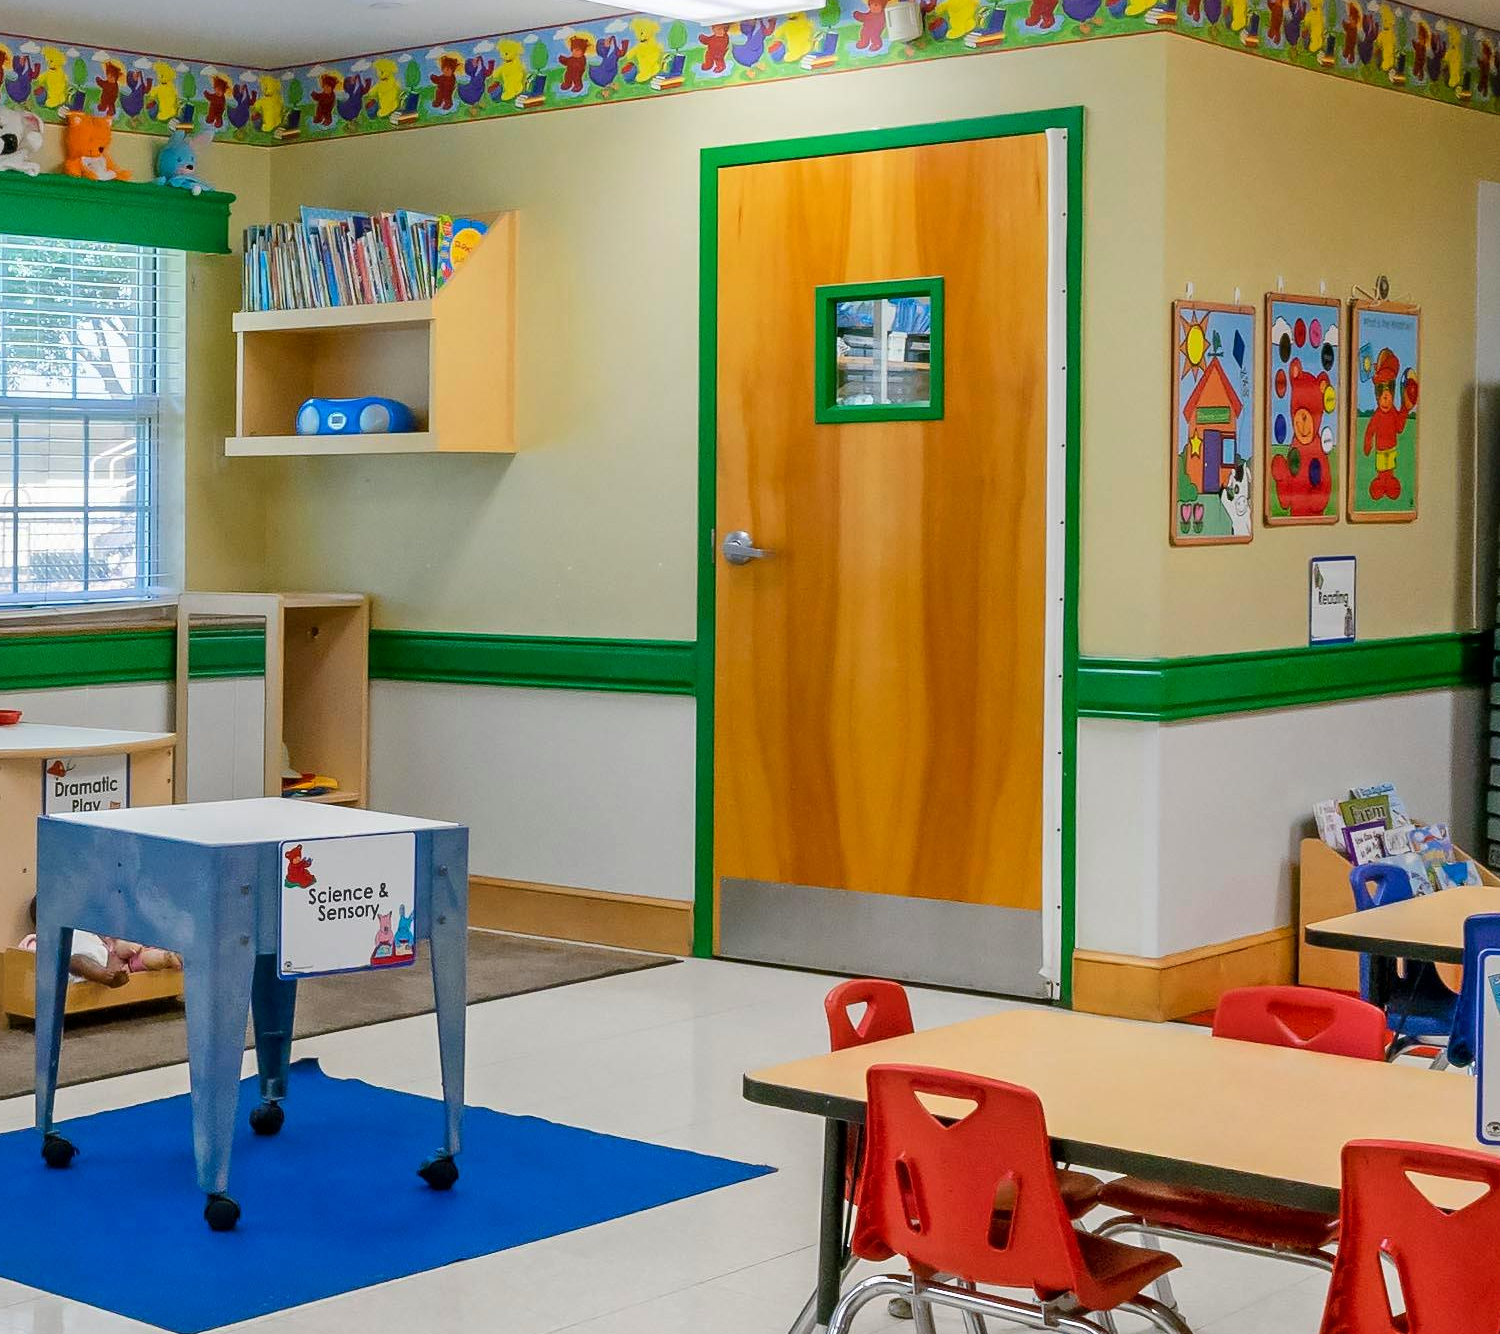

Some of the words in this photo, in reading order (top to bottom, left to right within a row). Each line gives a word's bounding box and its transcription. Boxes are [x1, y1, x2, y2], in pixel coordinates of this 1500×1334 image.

[1318, 590, 1349, 608] Reading
[54, 776, 118, 798] Dramatic
[71, 798, 101, 813] Play
[308, 885, 374, 905] Science
[378, 882, 389, 898] &
[318, 903, 380, 922] Sensory
